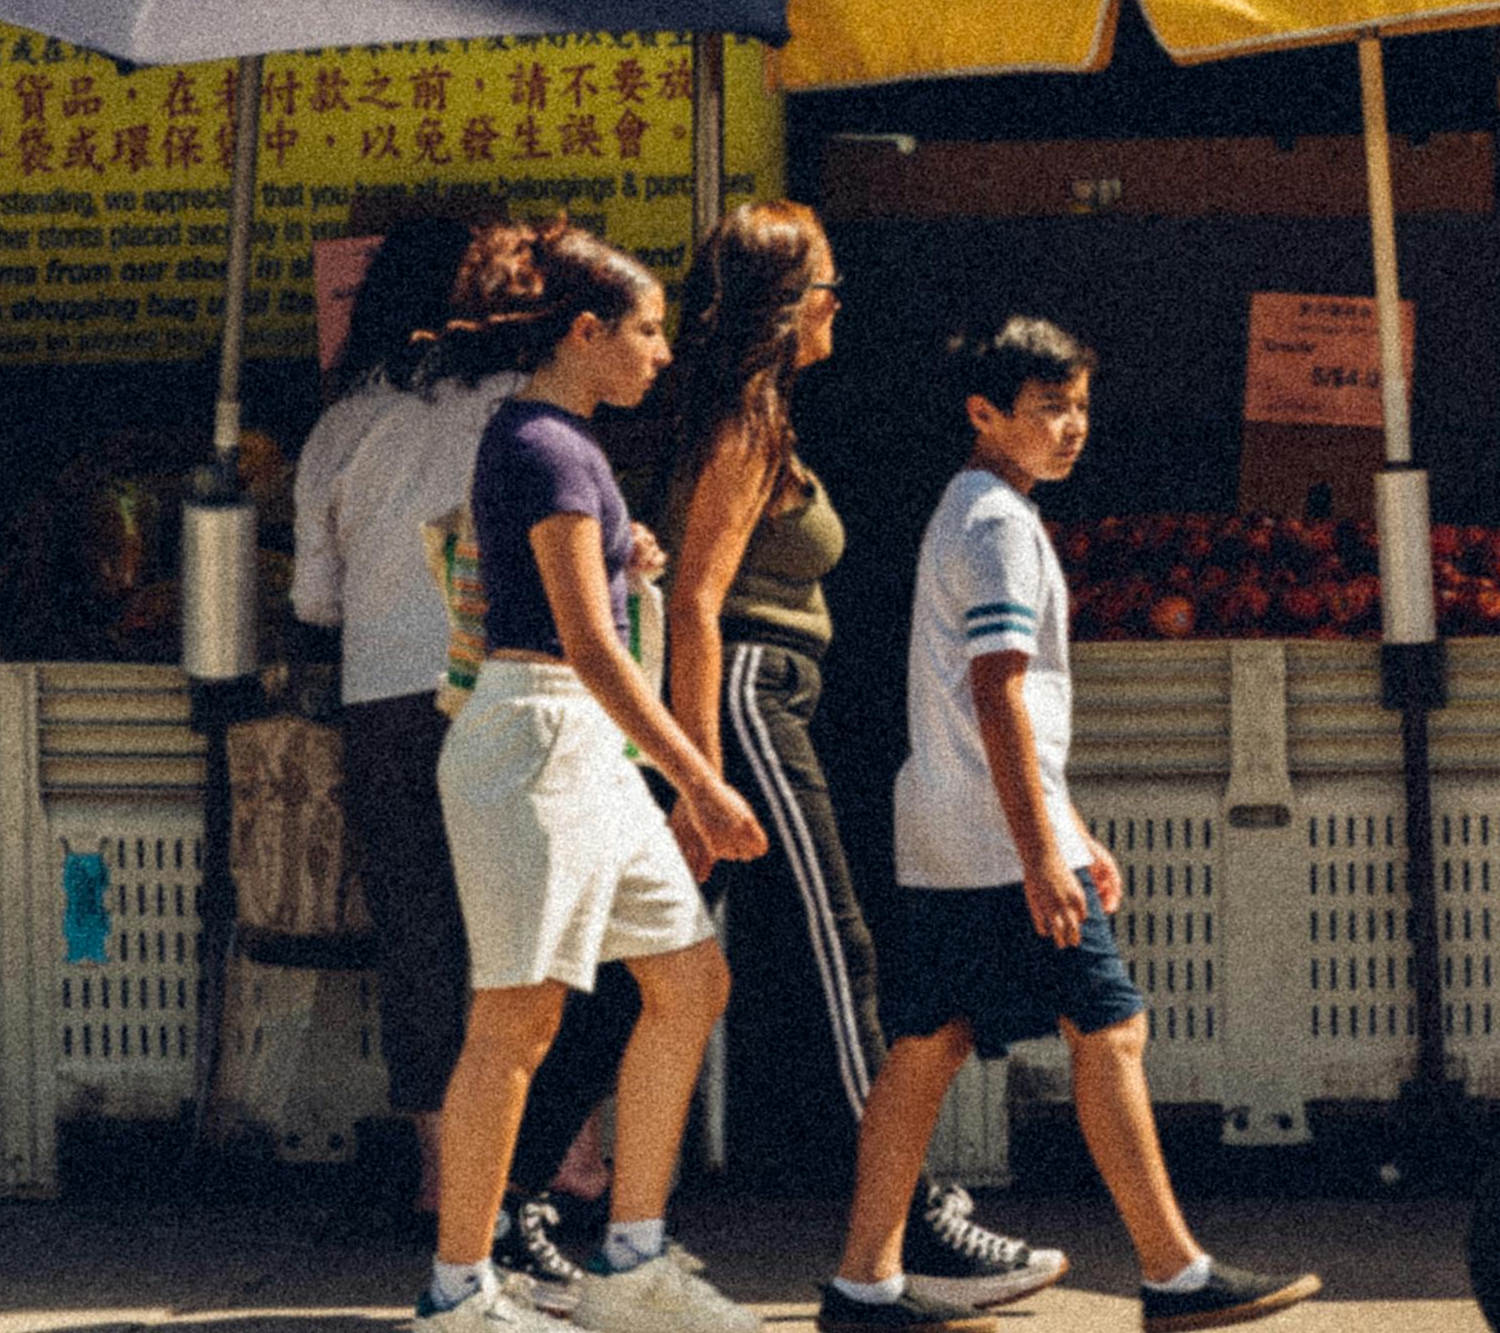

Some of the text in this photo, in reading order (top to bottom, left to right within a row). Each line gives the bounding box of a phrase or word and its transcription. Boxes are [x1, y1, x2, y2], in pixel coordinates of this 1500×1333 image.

[105, 191, 136, 210] we
[47, 259, 111, 285] from
[120, 262, 168, 282] our
[11, 295, 139, 324] shopping
